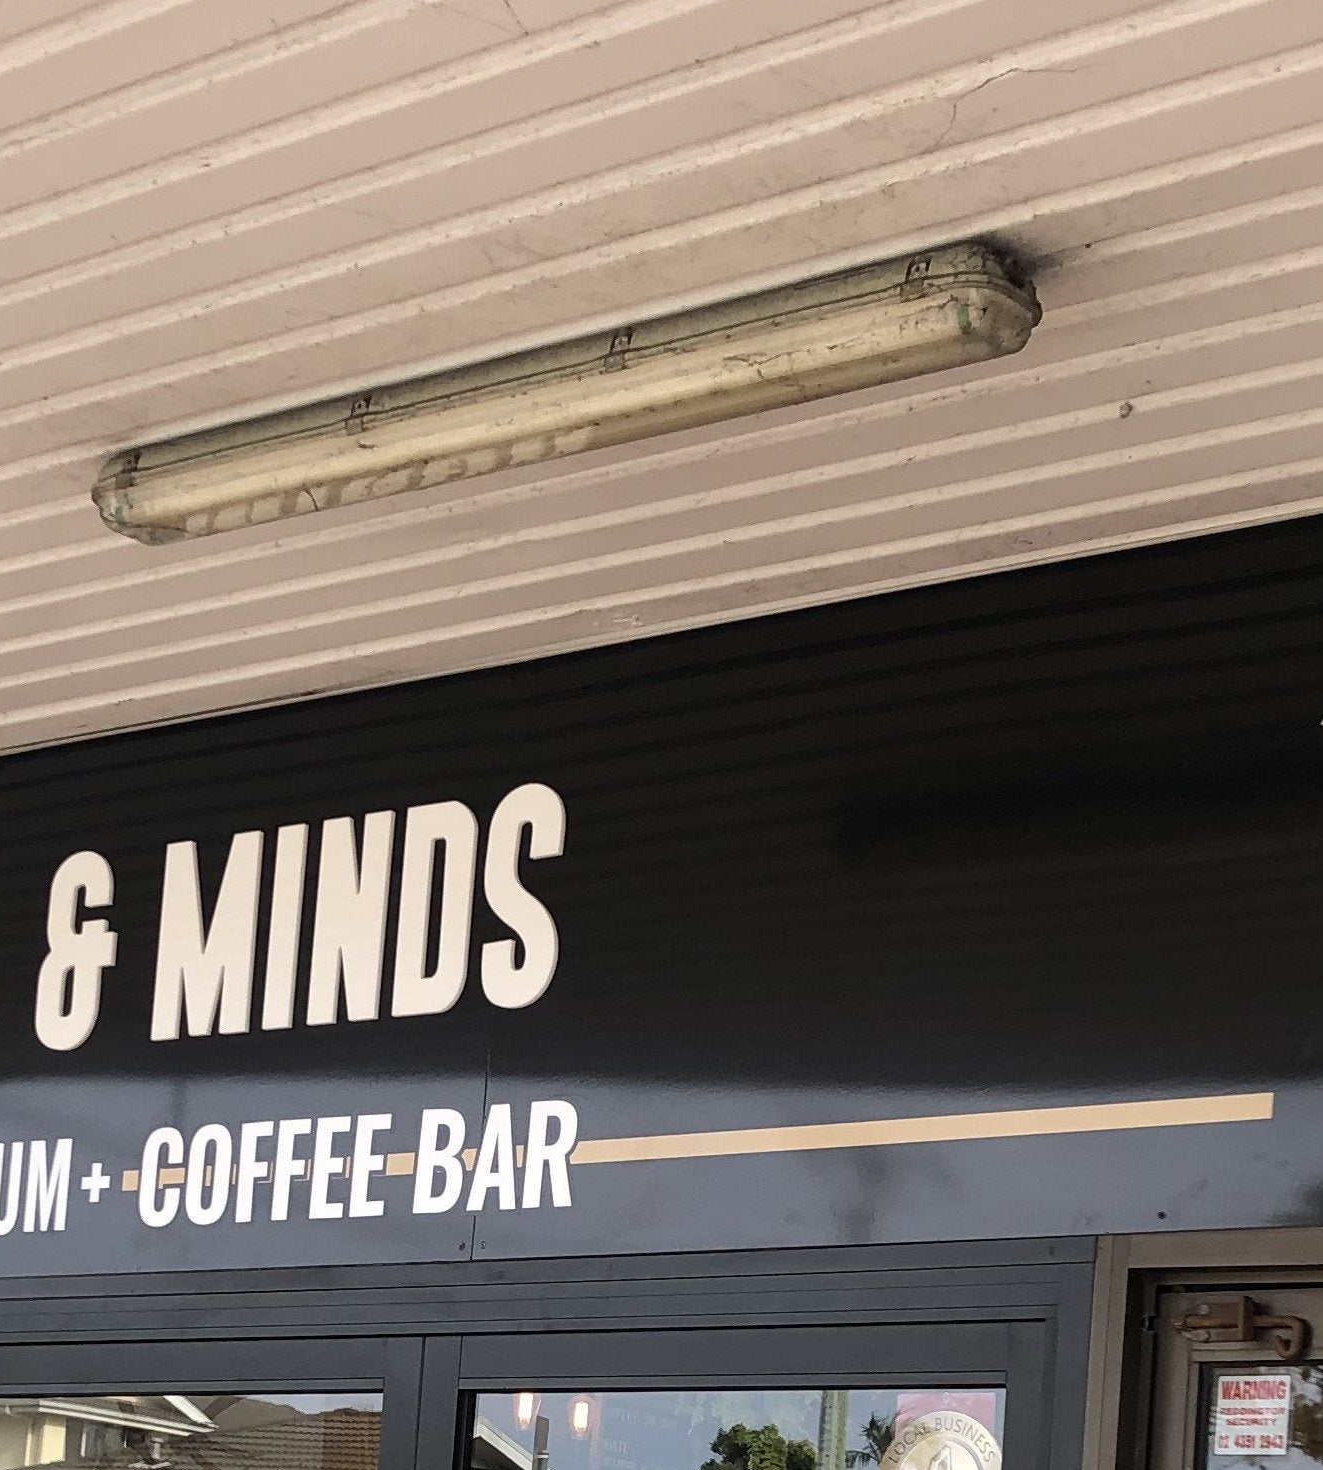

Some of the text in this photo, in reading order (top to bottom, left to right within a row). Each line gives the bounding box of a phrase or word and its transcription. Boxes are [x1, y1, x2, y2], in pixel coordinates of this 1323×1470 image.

[34, 850, 118, 1051] &
[150, 781, 567, 1042] MINDS
[138, 1112, 393, 1229] COFFEE
[411, 1098, 579, 1215] BAR
[887, 1417, 996, 1465] LOCAL BUSINESS
